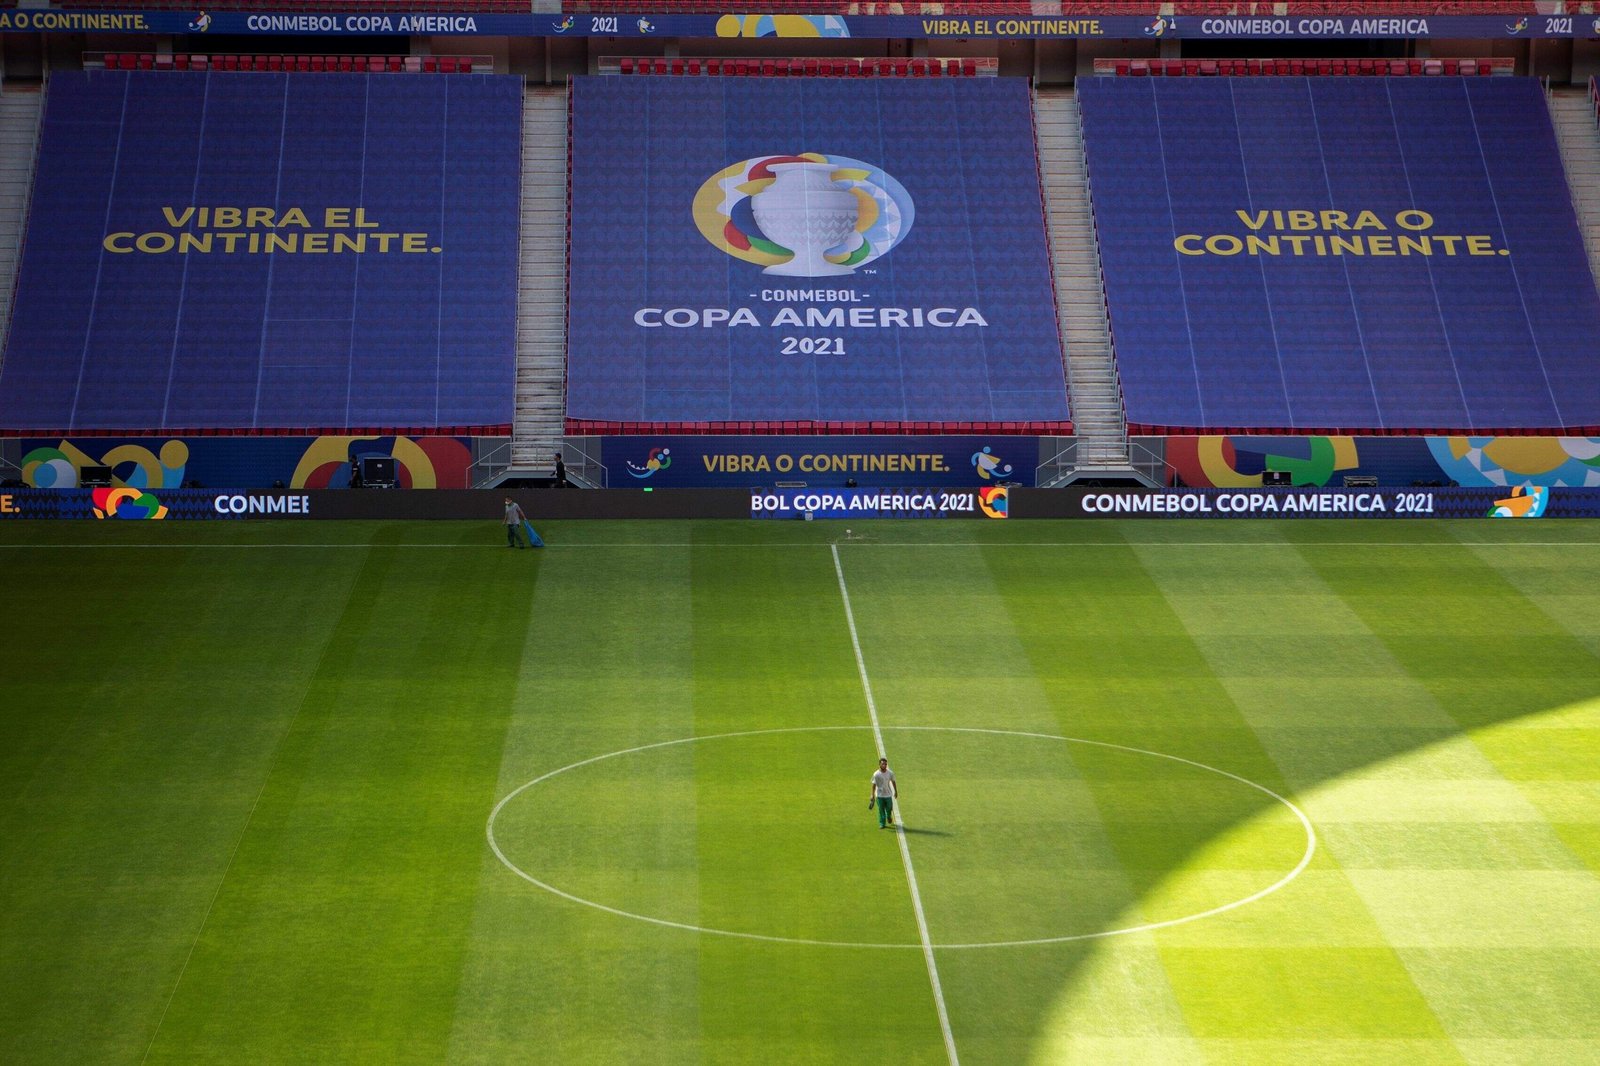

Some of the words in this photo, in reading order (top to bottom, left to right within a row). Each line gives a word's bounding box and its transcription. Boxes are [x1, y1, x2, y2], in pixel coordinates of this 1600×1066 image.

[14, 12, 29, 29] O
[32, 12, 149, 31] CONTINENTE.
[247, 15, 341, 31] CONMEBOL
[345, 15, 393, 32] COPA
[397, 15, 477, 32] AMERICA
[591, 16, 618, 33] 2021
[922, 19, 971, 35] VIBRA
[974, 20, 992, 35] EL
[995, 19, 1104, 36] CONTINENTE.
[1201, 18, 1294, 35] CONMEBOL
[1298, 18, 1345, 35] COPA
[1349, 18, 1429, 35] AMERICA
[1545, 17, 1573, 34] 2021
[161, 206, 312, 229] VIBRA
[324, 207, 380, 229] EL
[1235, 209, 1388, 232] VIBRA
[1394, 209, 1435, 232] O
[102, 231, 443, 255] CONTINENTE.
[1173, 233, 1511, 257] CONTINENTE.
[633, 307, 761, 328] COPA
[770, 307, 989, 328] AMERICA
[780, 336, 847, 356] 2021
[702, 454, 771, 473] VIBRA
[775, 454, 794, 473] O
[799, 453, 951, 473] CONTINENTE.
[750, 495, 790, 511] BOL
[794, 494, 846, 511] COPA
[849, 494, 937, 511] AMERICA
[940, 493, 975, 511] 2021
[1081, 493, 1212, 513] CONMEBOL
[1216, 493, 1278, 513] COPA
[1281, 493, 1386, 512] AMERICA
[1394, 492, 1434, 513] 2021
